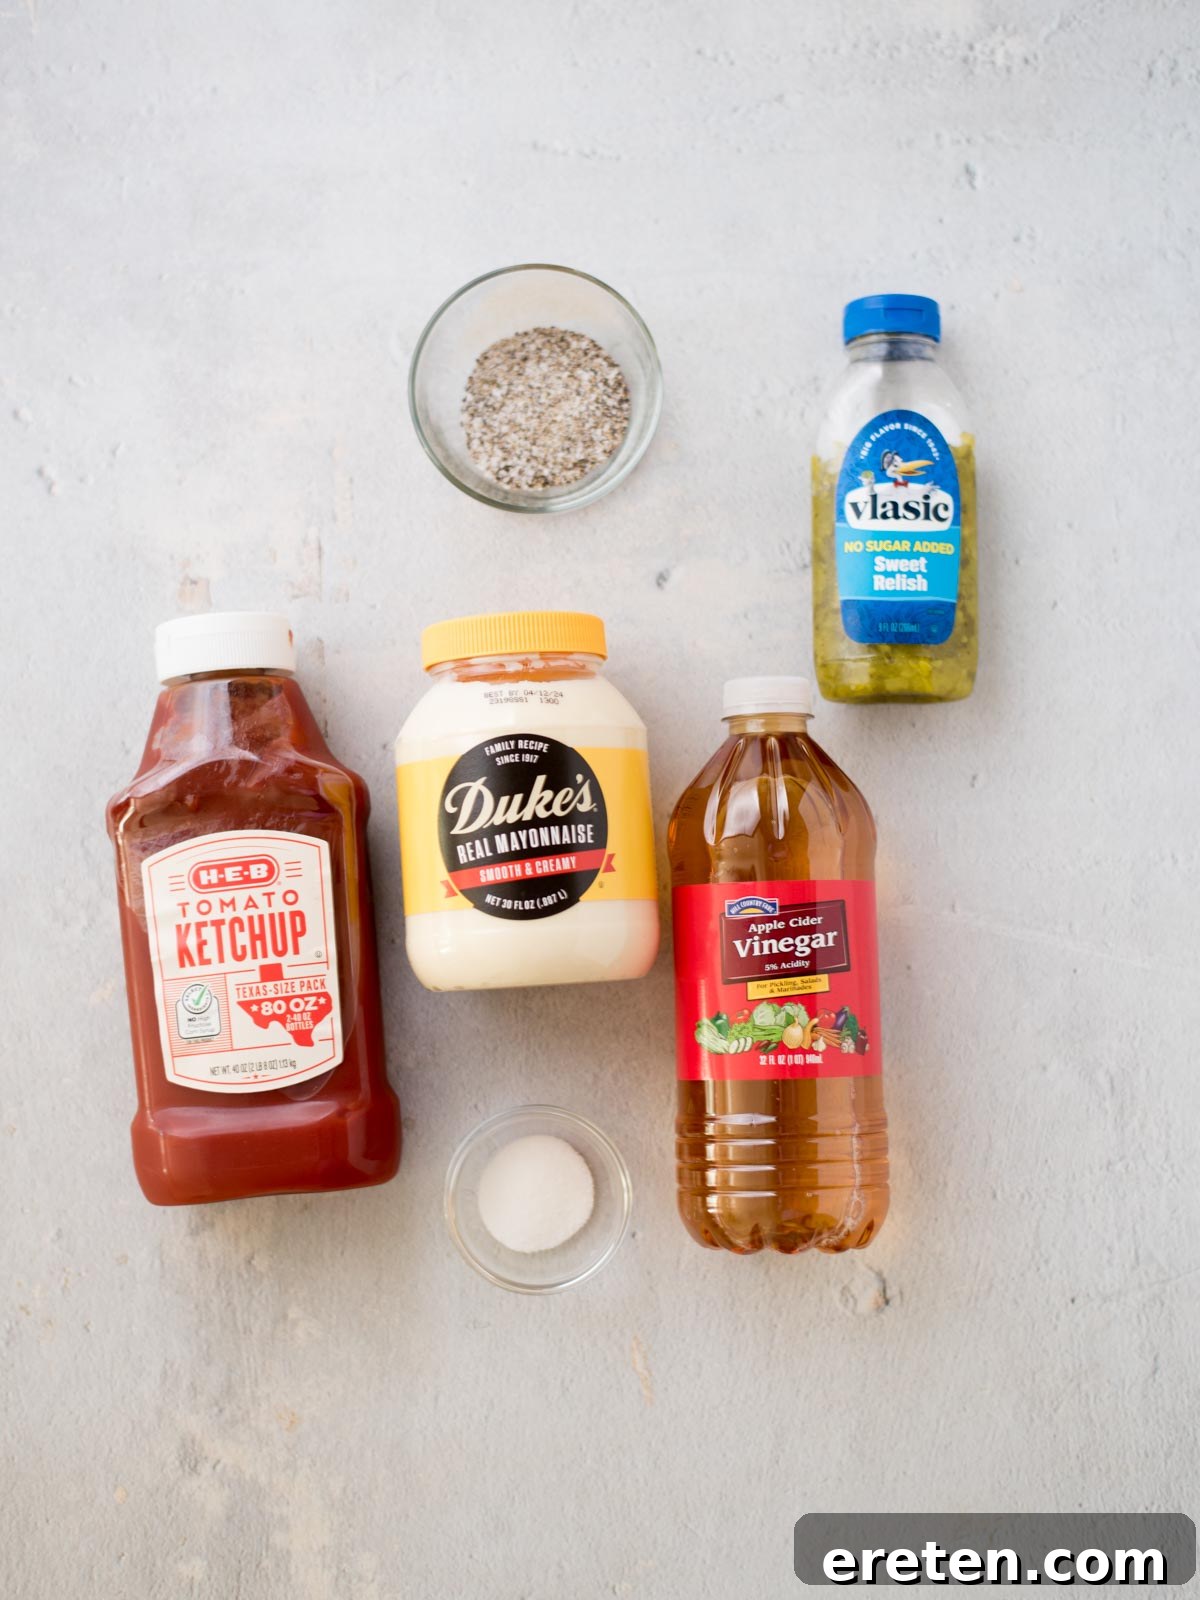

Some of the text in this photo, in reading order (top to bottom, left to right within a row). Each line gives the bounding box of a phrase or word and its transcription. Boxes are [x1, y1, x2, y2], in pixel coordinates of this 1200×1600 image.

[849, 494, 949, 521] vlasic
[844, 540, 955, 555] NO SUGAR ADDED
[874, 556, 927, 573] Sweet
[873, 574, 928, 591] Relish
[484, 740, 549, 756] FAMILY RECIPE
[496, 754, 539, 766] SINCE 1917
[444, 774, 597, 834] Duke's
[457, 824, 594, 864] REAL MAYONNAISE
[199, 863, 269, 885] H-E-B
[479, 856, 576, 882] SMOOTH & CREAMY
[177, 890, 298, 918] TOMATO
[485, 894, 500, 908] NET
[502, 899, 512, 909] 30
[558, 889, 568, 899] L)
[748, 915, 823, 934] Apple Cider
[175, 910, 307, 968] KETCHUP
[733, 930, 838, 958] Vinegar
[765, 959, 810, 971] 5% Acidity
[236, 979, 326, 999] TEXAS-SIZE PACK
[261, 996, 318, 1016] 80 OZ
[286, 1021, 313, 1031] BOTTLES
[210, 1066, 220, 1076] NET
[241, 1064, 248, 1072] OZ
